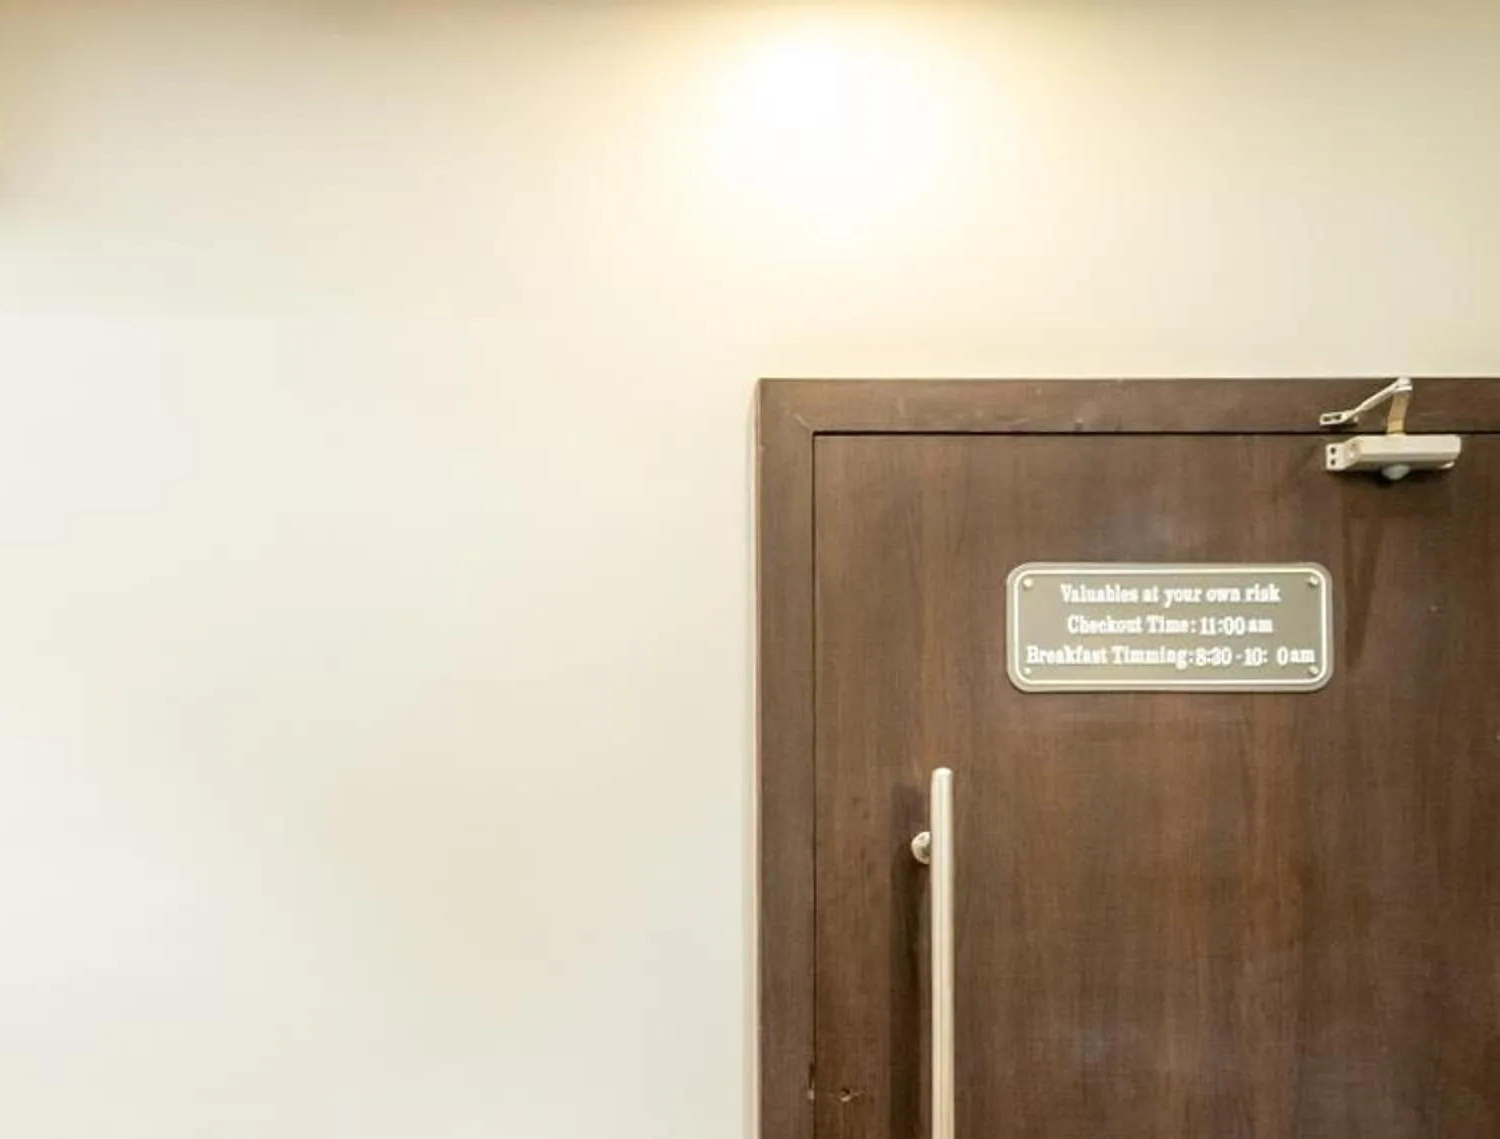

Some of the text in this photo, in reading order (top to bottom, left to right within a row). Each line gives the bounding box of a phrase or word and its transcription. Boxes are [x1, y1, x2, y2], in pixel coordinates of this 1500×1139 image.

[1061, 583, 1282, 608] Valuables at your own risk
[1067, 614, 1142, 634] Checkout
[1199, 616, 1245, 635] 11:00
[1247, 619, 1273, 633] am
[1026, 645, 1107, 664] Breakfast
